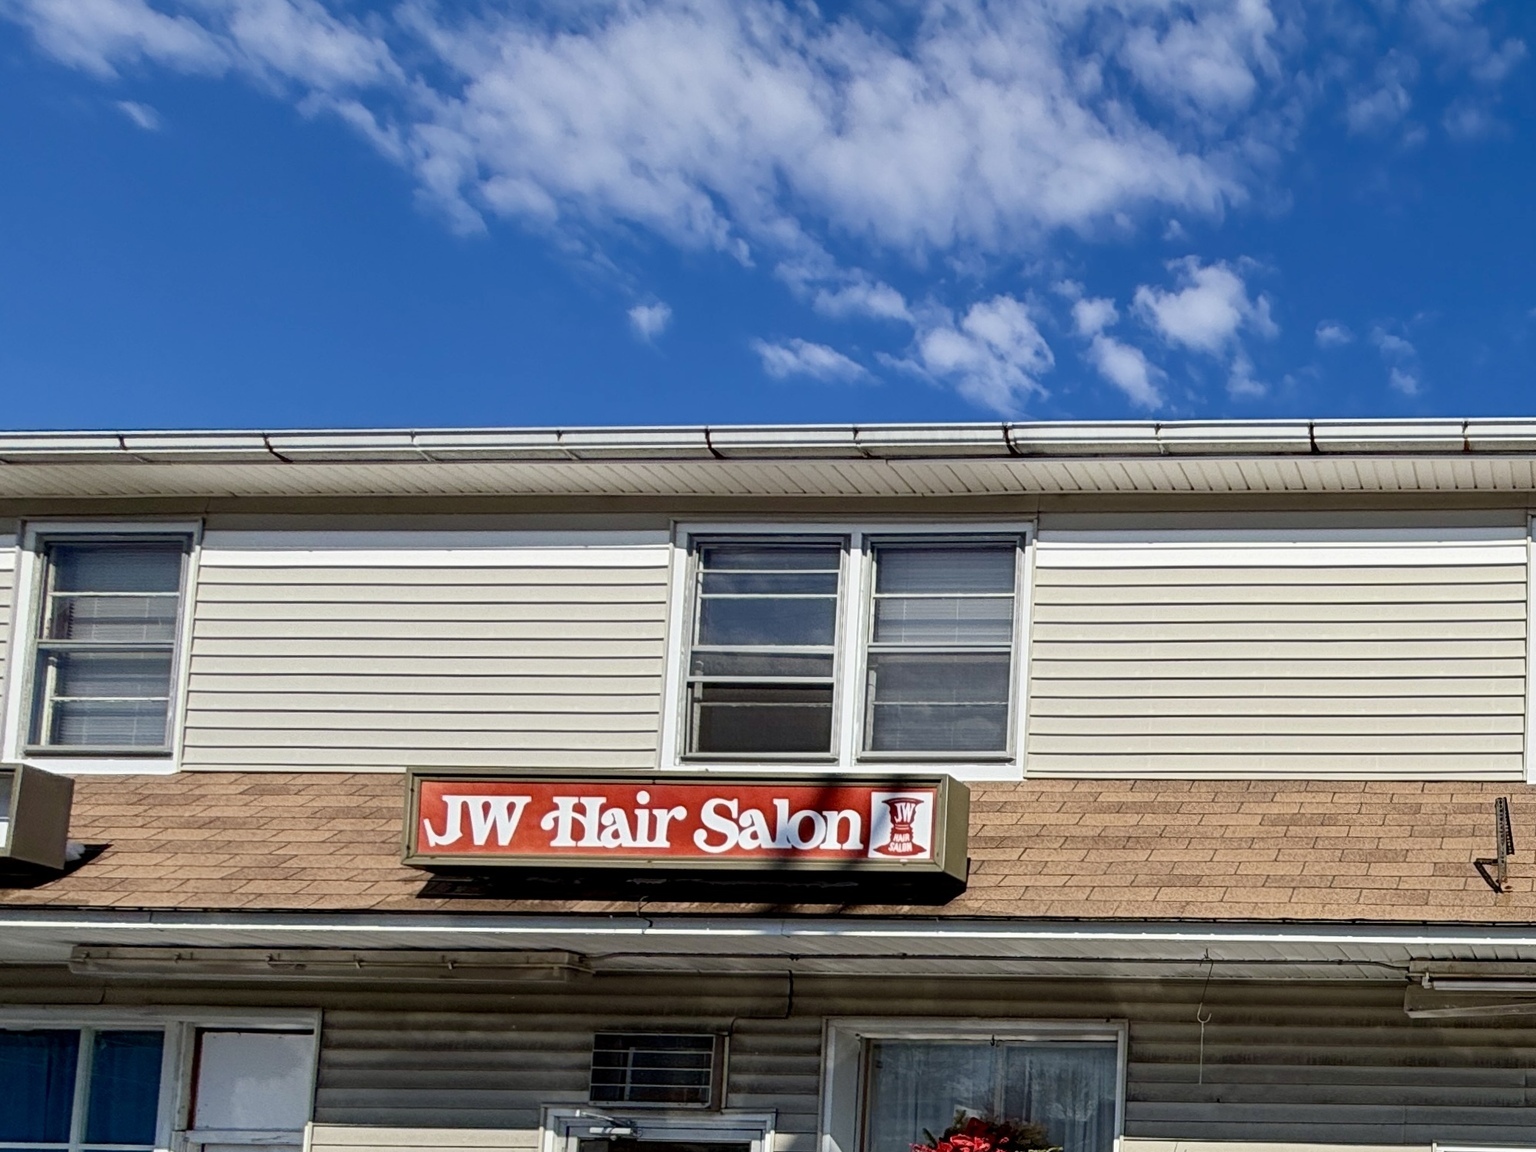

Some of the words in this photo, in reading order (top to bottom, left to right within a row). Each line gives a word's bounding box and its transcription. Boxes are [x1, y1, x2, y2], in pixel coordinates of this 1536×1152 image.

[894, 802, 916, 823] JW
[424, 795, 532, 847] JW
[541, 790, 687, 848] Hair
[693, 797, 863, 854] Salon
[892, 833, 911, 842] HAIR
[888, 842, 913, 852] SALON
